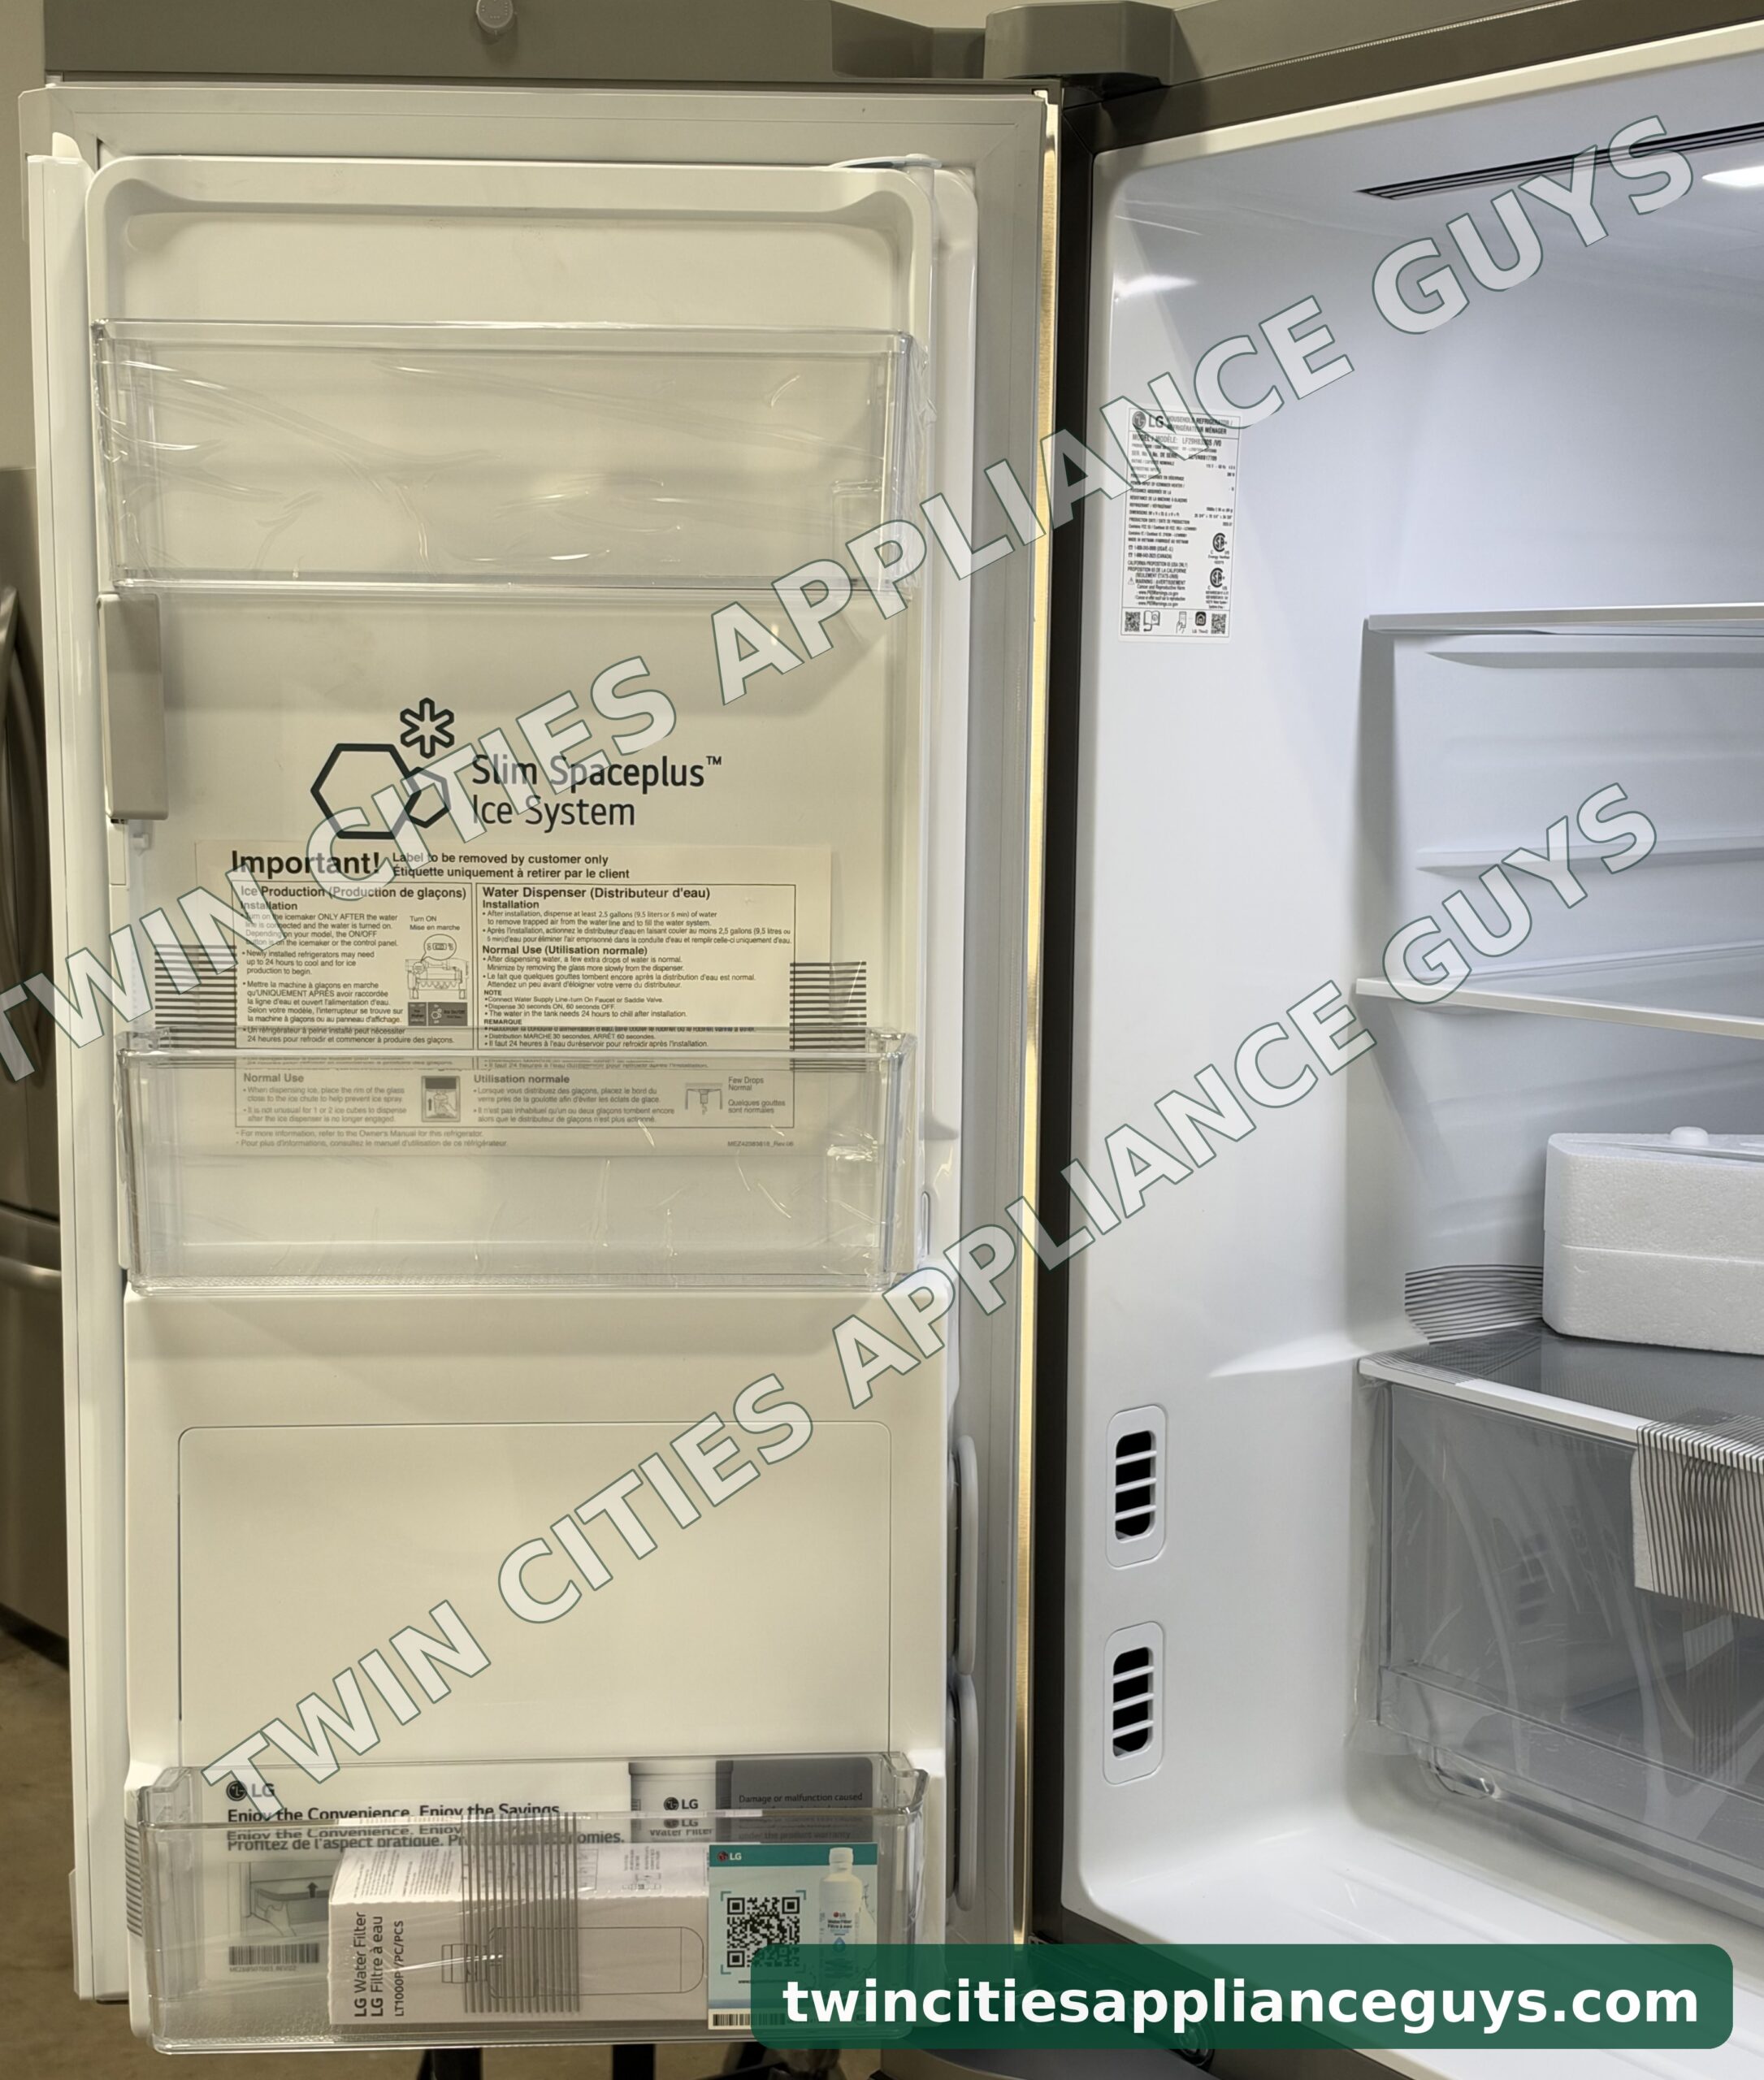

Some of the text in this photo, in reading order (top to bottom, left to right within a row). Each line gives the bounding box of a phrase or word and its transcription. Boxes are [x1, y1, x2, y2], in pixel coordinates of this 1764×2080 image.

[1149, 415, 1164, 428] LG
[472, 754, 538, 786] Slim
[474, 795, 635, 833] Ice System
[232, 850, 379, 879] Important!
[392, 853, 423, 863] Label
[442, 853, 456, 862] be
[459, 854, 508, 864] removed
[511, 854, 525, 866] by
[528, 855, 582, 864] customer
[584, 855, 609, 867] only
[394, 864, 630, 880] Étiquette uniquement à retirer par le client
[241, 886, 466, 901] Ice Production (Production de glaçons)
[482, 886, 711, 901] Water Dispenser (Distributeur d'eau)
[241, 901, 298, 911] Installation
[482, 899, 540, 909] Installation
[284, 912, 399, 921] icemaker ONLY AFTER the water
[303, 921, 318, 930] and
[319, 921, 330, 930] the
[331, 921, 350, 930] water
[351, 921, 358, 930] is
[358, 921, 379, 930] turned
[409, 923, 425, 931] Mise
[436, 923, 461, 931] marche
[293, 930, 378, 939] your model, the ON/OFF
[245, 950, 375, 960] Newly installed refrigerators may need
[482, 945, 648, 957] Normal Use (Utilisation normale)
[246, 958, 357, 968] up to 24 hours to cool and for ice
[487, 955, 504, 963] After
[504, 955, 541, 964] dispensing
[601, 956, 622, 964] drops
[246, 967, 283, 977] production
[284, 967, 291, 975] to
[244, 1073, 305, 1082] Normal Use
[474, 1074, 570, 1084] Utilisation normale
[744, 1077, 765, 1086] Drops
[728, 1099, 760, 1107] Quelques
[251, 1783, 275, 1797] LG
[739, 1795, 771, 1804] Damage
[785, 1793, 834, 1801] malfunction
[834, 1792, 863, 1801] caused
[681, 1798, 699, 1809] LG
[228, 1809, 271, 1823] Enjoy
[276, 1808, 303, 1821] the
[419, 1804, 464, 1817] Enjoy
[467, 1803, 494, 1814] the
[228, 1839, 288, 1851] Profitez
[292, 1838, 312, 1849] de
[314, 1836, 373, 1852] l'aspect
[729, 1852, 742, 1861] LG
[353, 1911, 367, 2017] LG Water Filter
[370, 1916, 384, 2017] LG Filtre à eau
